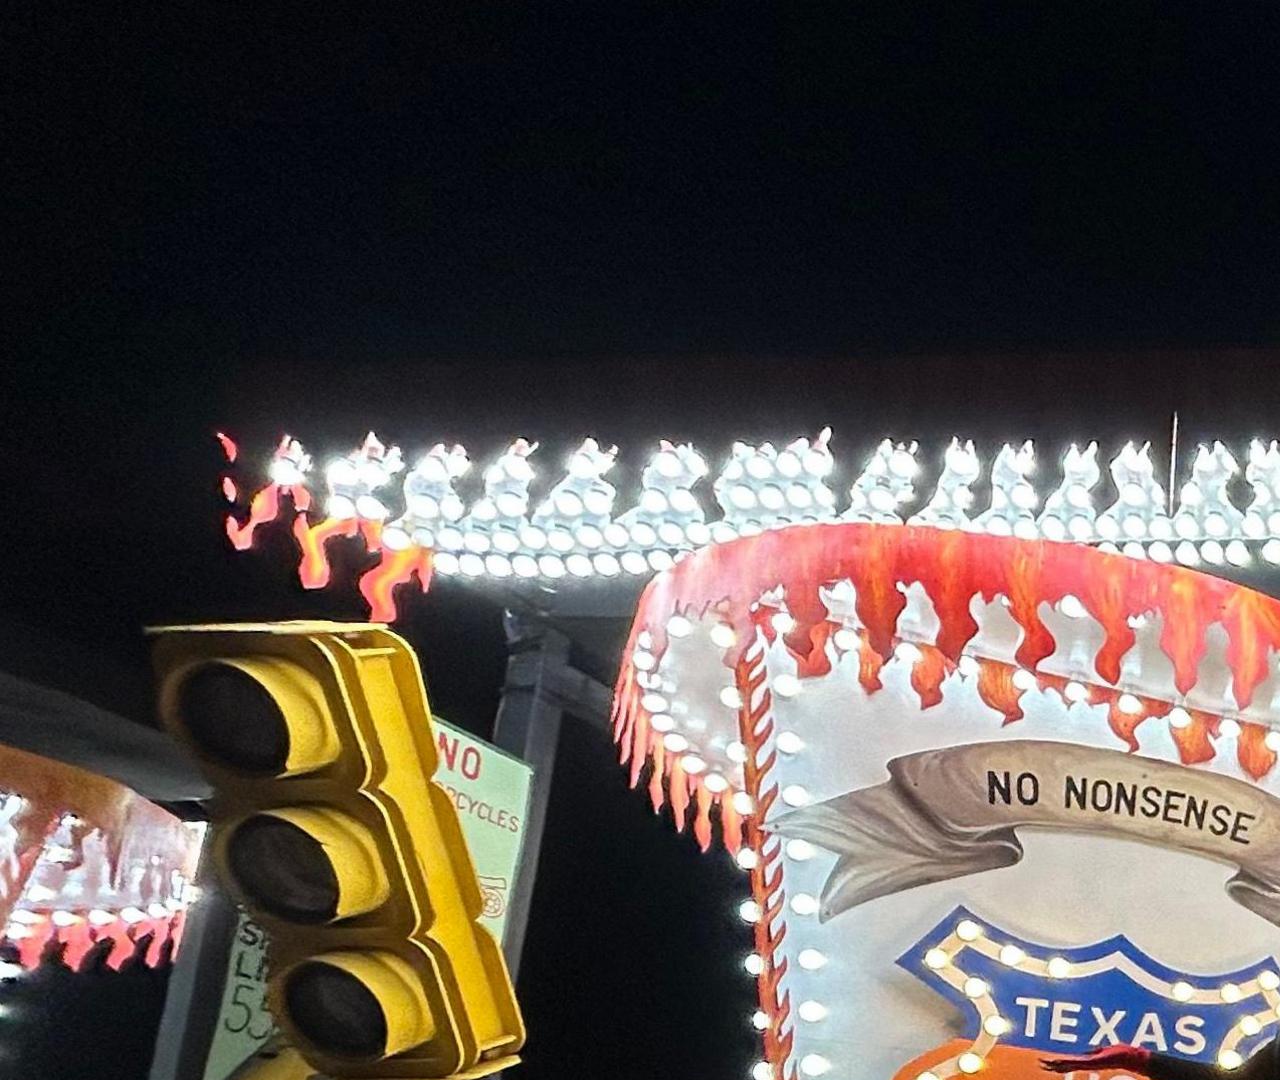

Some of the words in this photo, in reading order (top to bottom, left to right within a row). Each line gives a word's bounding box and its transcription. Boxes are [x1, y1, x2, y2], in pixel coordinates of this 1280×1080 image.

[438, 731, 482, 781] NO
[437, 780, 520, 833] CYCLES
[987, 770, 1039, 806] NO
[1064, 775, 1256, 845] NONSENSE
[1015, 996, 1207, 1056] TEXAS
